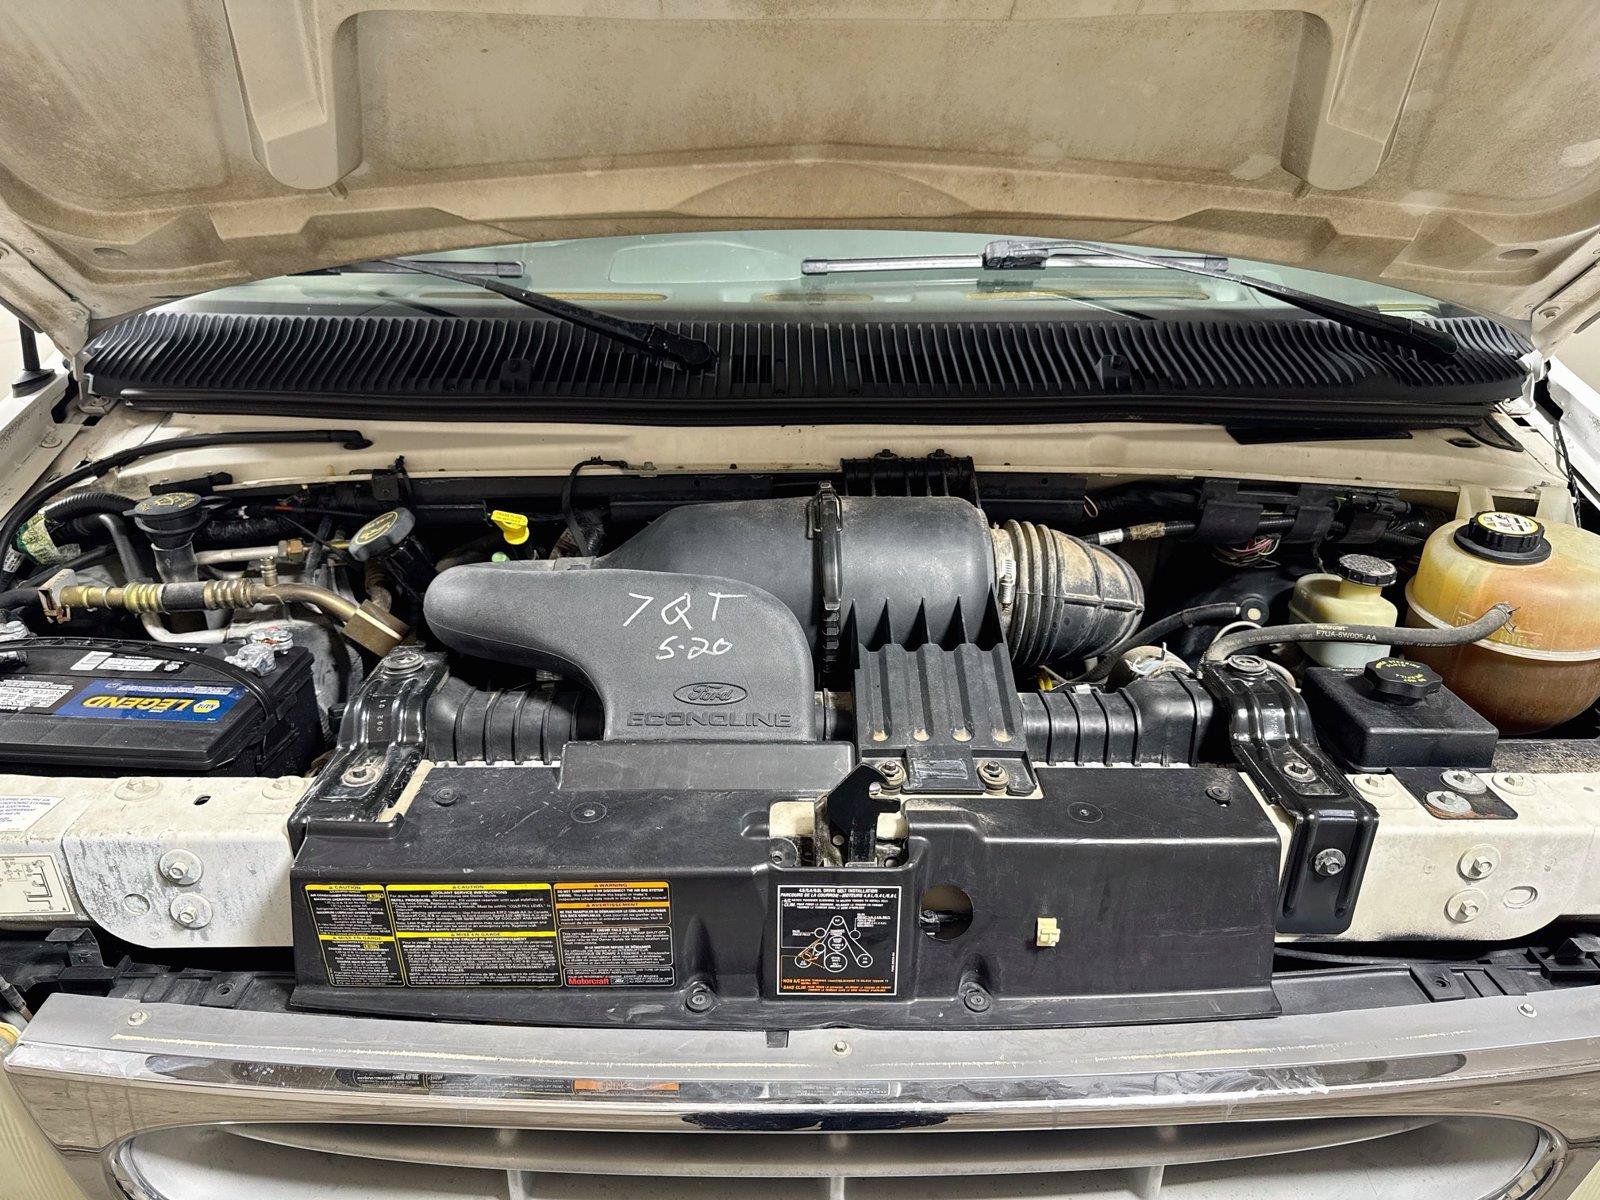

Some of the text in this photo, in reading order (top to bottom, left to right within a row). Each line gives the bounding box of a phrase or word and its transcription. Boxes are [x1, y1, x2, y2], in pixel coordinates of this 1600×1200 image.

[623, 592, 654, 626] 7
[687, 683, 734, 702] Ford
[82, 696, 196, 712] LEGEND
[626, 711, 792, 728] ECONOLINE
